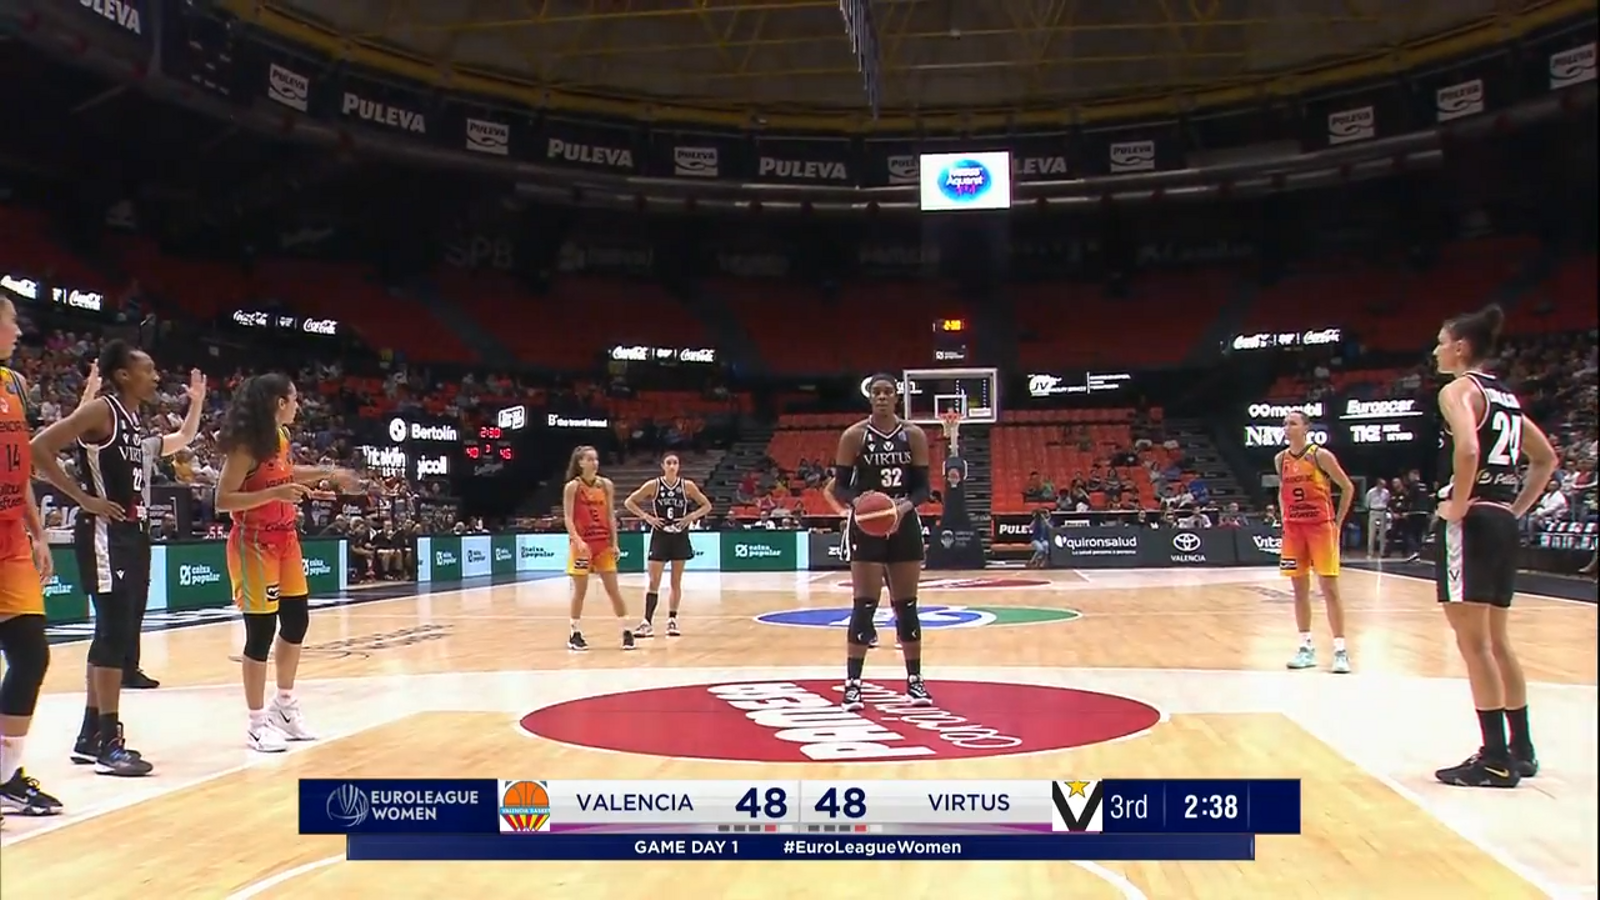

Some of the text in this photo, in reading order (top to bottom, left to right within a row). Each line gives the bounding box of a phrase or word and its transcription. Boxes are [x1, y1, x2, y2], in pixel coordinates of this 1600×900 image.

[80, 0, 141, 35] LEVA
[342, 92, 425, 133] PULEVA
[470, 123, 507, 139] PULEVA
[547, 138, 634, 167] PULEVA
[678, 151, 716, 162] PULEVA
[758, 157, 847, 180] PULEVA
[1012, 157, 1067, 175] LEVA
[863, 450, 911, 466] VIRTUS
[880, 467, 902, 488] 32
[1293, 488, 1304, 502] 9
[999, 524, 1035, 535] PULE
[1170, 554, 1206, 562] VALENCIA
[706, 682, 938, 760] PAMESA
